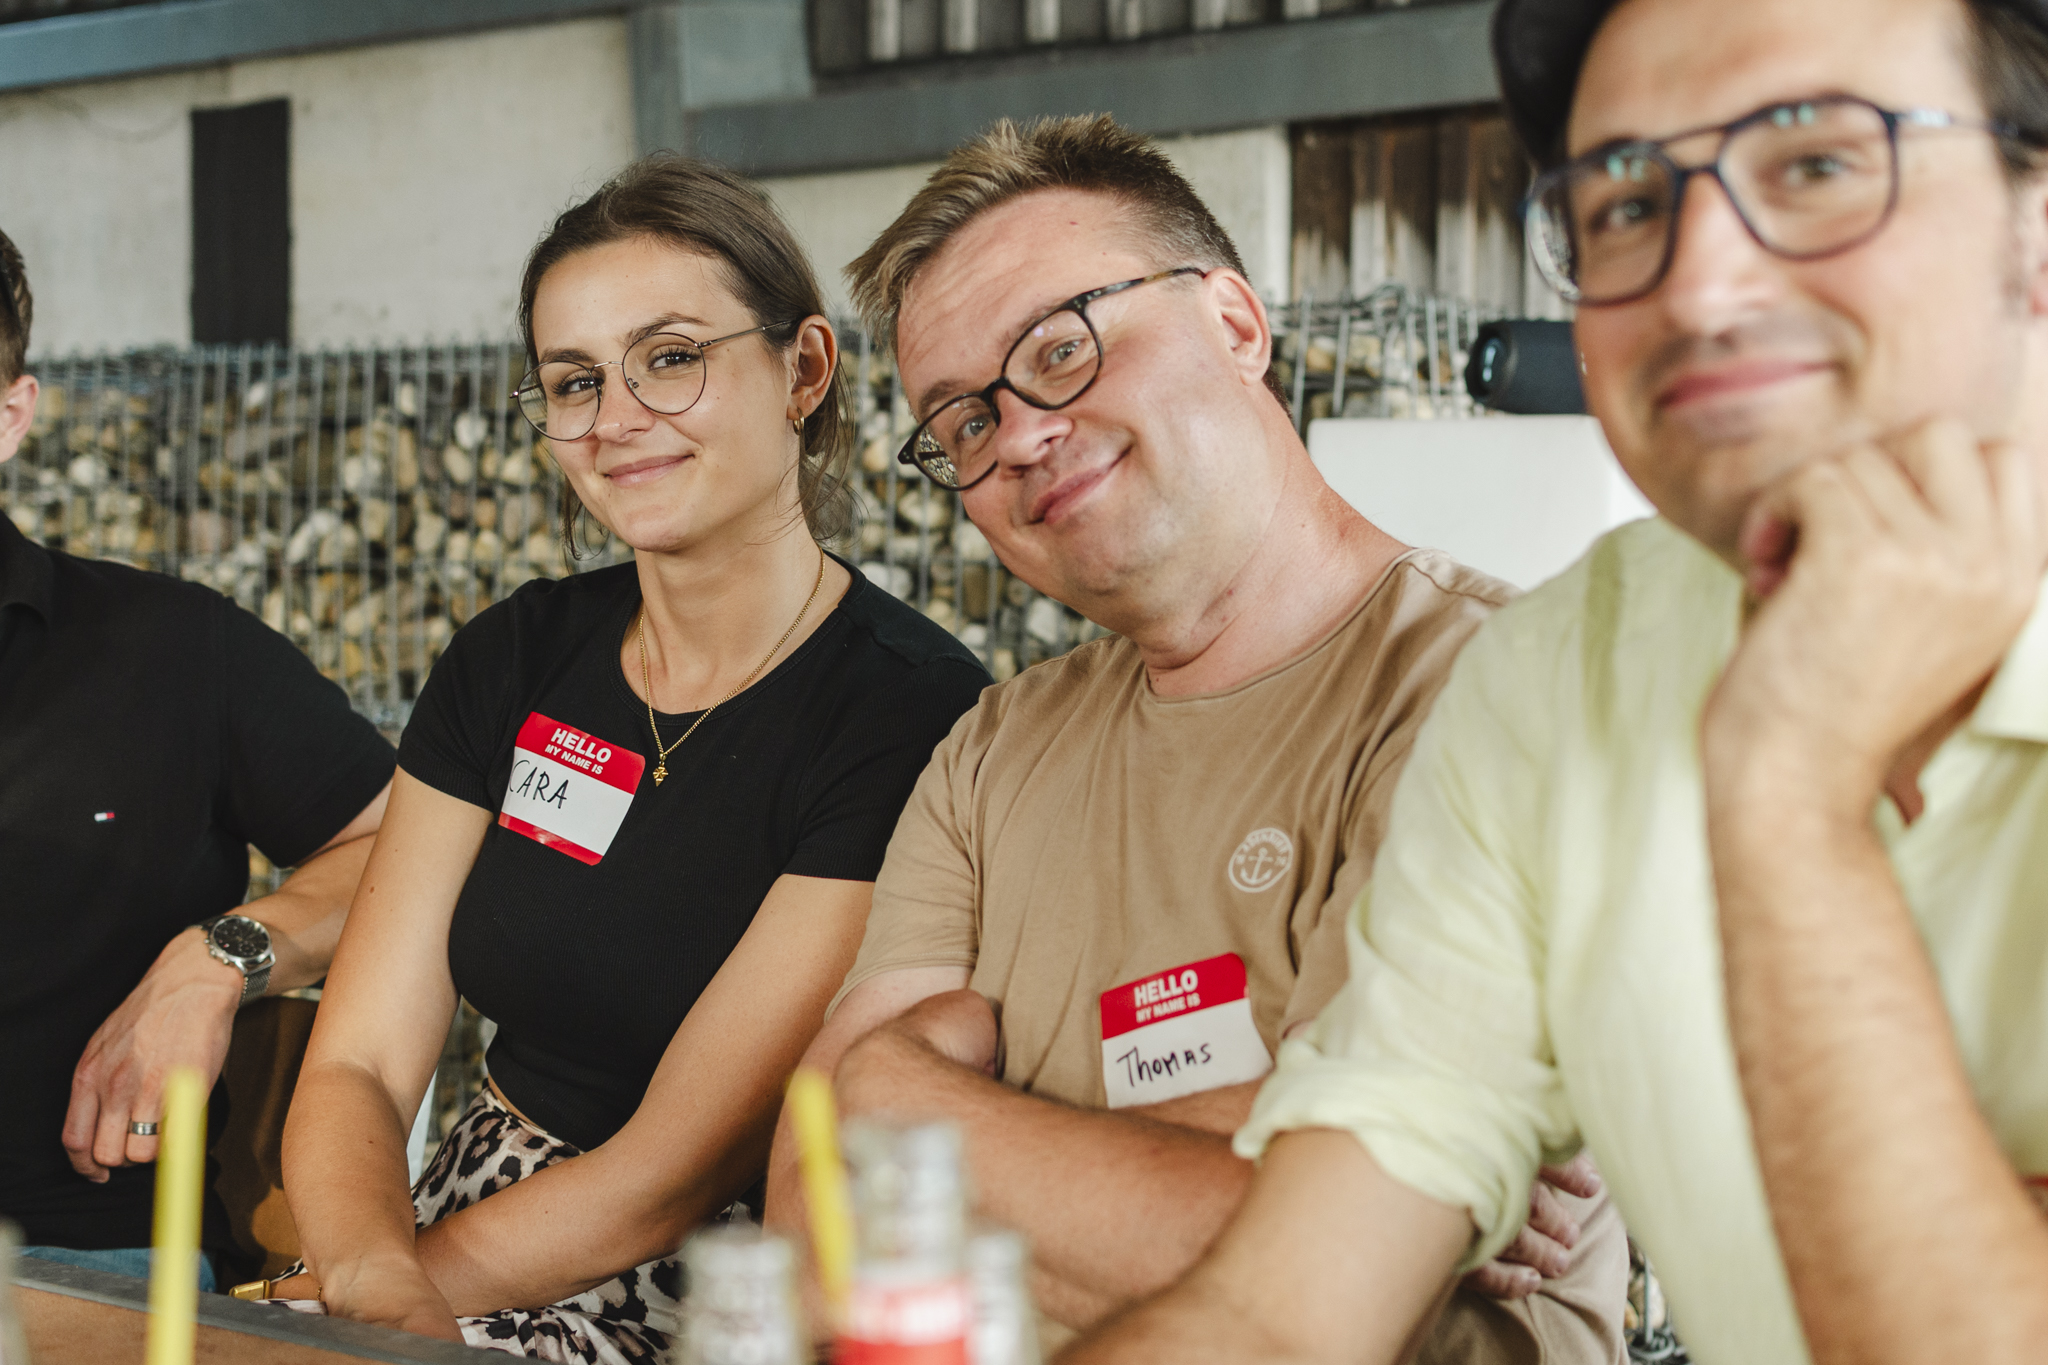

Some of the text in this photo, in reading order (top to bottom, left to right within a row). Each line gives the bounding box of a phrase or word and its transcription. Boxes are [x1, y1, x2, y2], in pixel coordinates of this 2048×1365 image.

[545, 744, 603, 775] MY NAME IS
[551, 728, 611, 763] HELLO
[509, 760, 569, 809] CARA
[1134, 969, 1198, 1007] HELLO
[1136, 993, 1201, 1023] MY NAME IS
